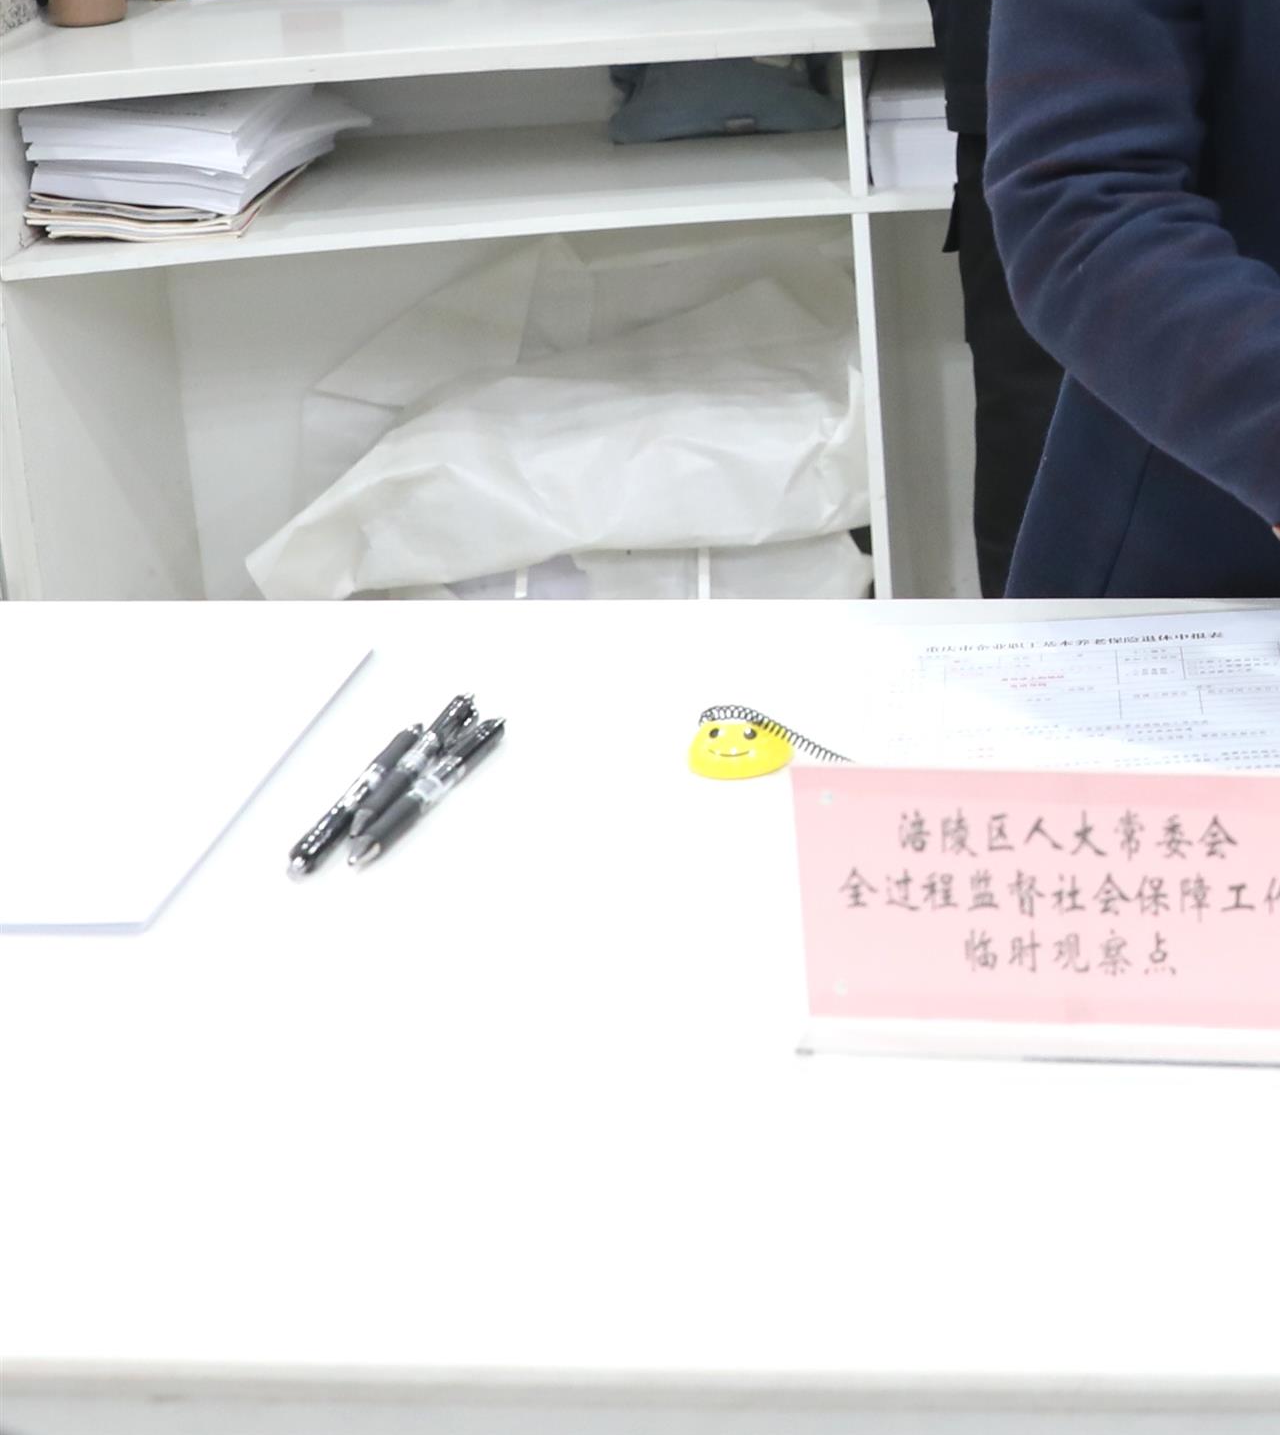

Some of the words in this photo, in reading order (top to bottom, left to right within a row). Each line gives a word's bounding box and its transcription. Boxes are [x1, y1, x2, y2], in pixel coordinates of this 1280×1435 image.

[898, 809, 1238, 860] 涪陵区人大常委会
[964, 929, 1178, 977] 临时观察点
